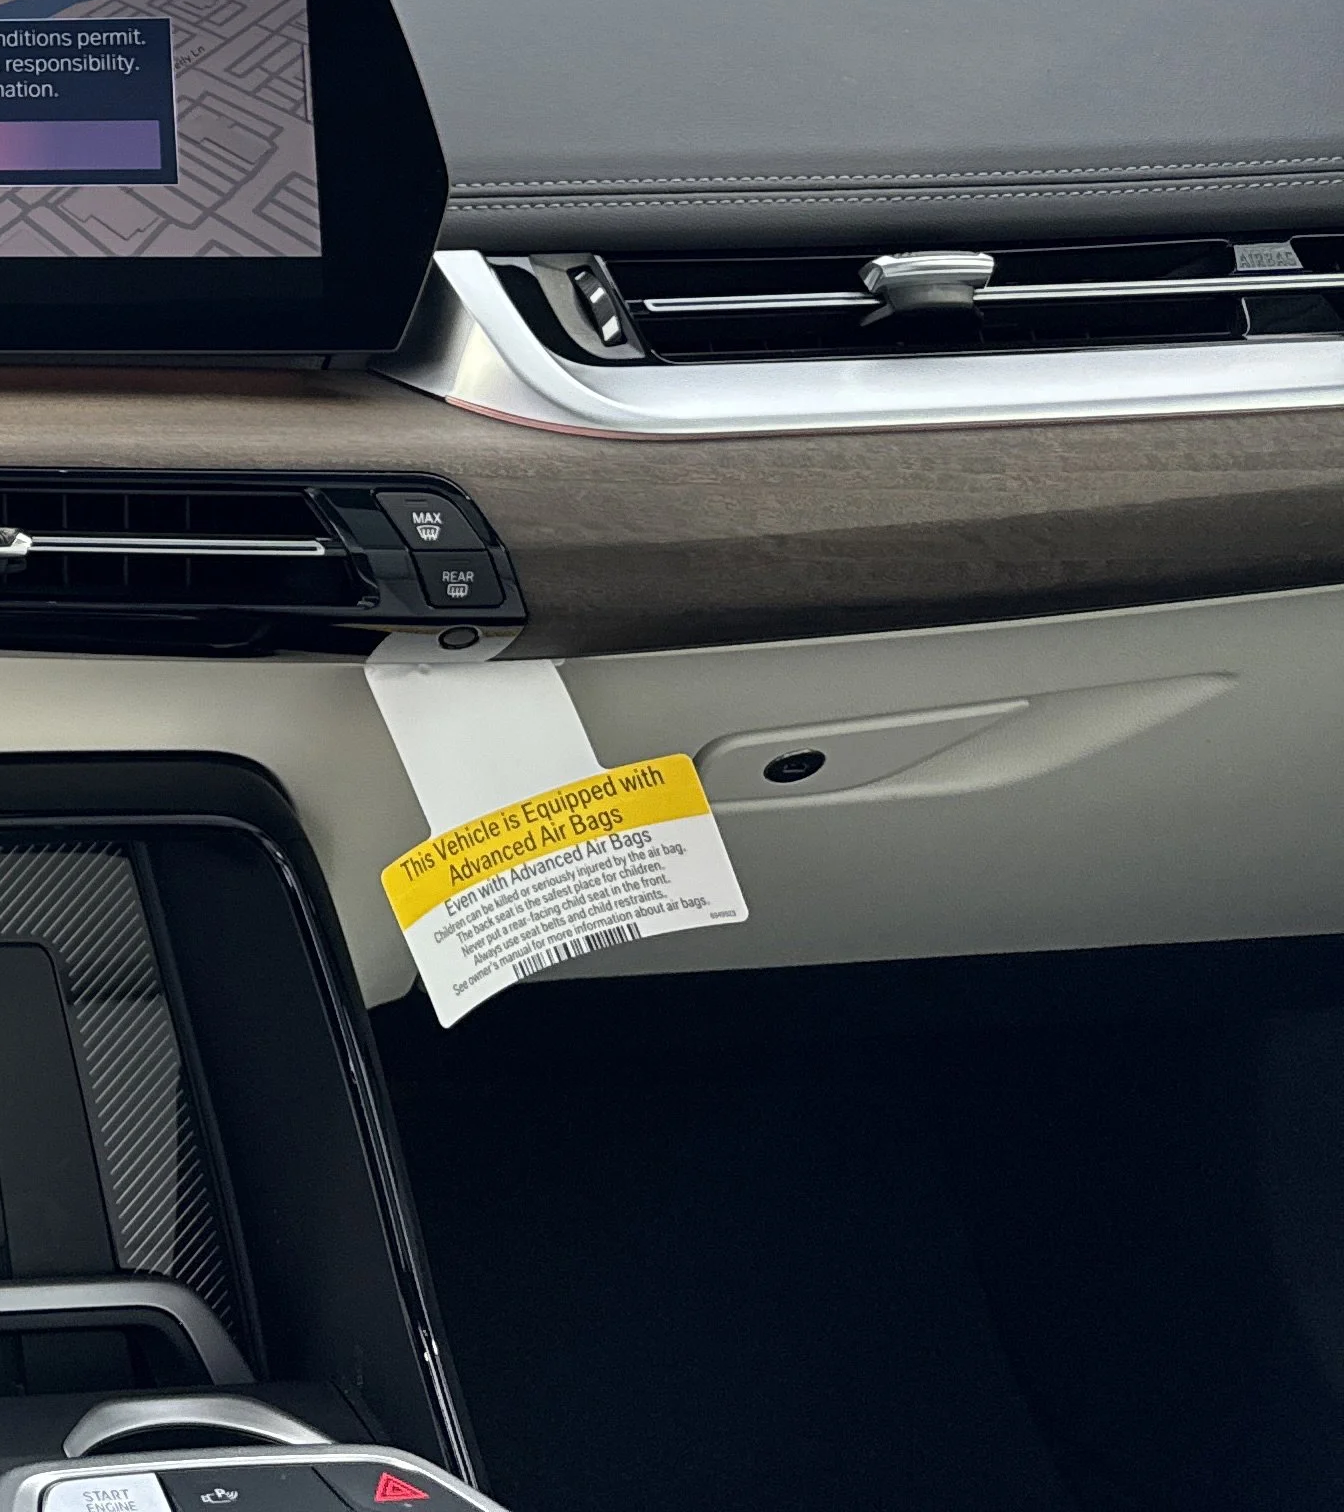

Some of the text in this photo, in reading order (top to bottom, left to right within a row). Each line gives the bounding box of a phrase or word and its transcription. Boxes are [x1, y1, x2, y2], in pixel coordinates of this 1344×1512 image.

[5, 54, 140, 75] responsibility.
[77, 28, 147, 49] permit.
[412, 512, 442, 524] MAX
[442, 571, 474, 582] REAR
[400, 765, 666, 882] This Vehicle is Equipped with
[449, 808, 624, 886] Advanced Air Bags
[434, 843, 687, 944] Children can be killed or seriously injured by the air bag.
[444, 830, 652, 917] Even with Advanced Air Bags
[456, 861, 665, 943] The back seat is the safest place for children.
[452, 895, 710, 996] See owner's manual for more information about air bags.
[461, 873, 671, 957] Never put a rear-facing child seat in the front.
[473, 888, 668, 966] Always use seat belts and child restraints.
[83, 1488, 129, 1502] START
[86, 1499, 138, 1512] ENGINE
